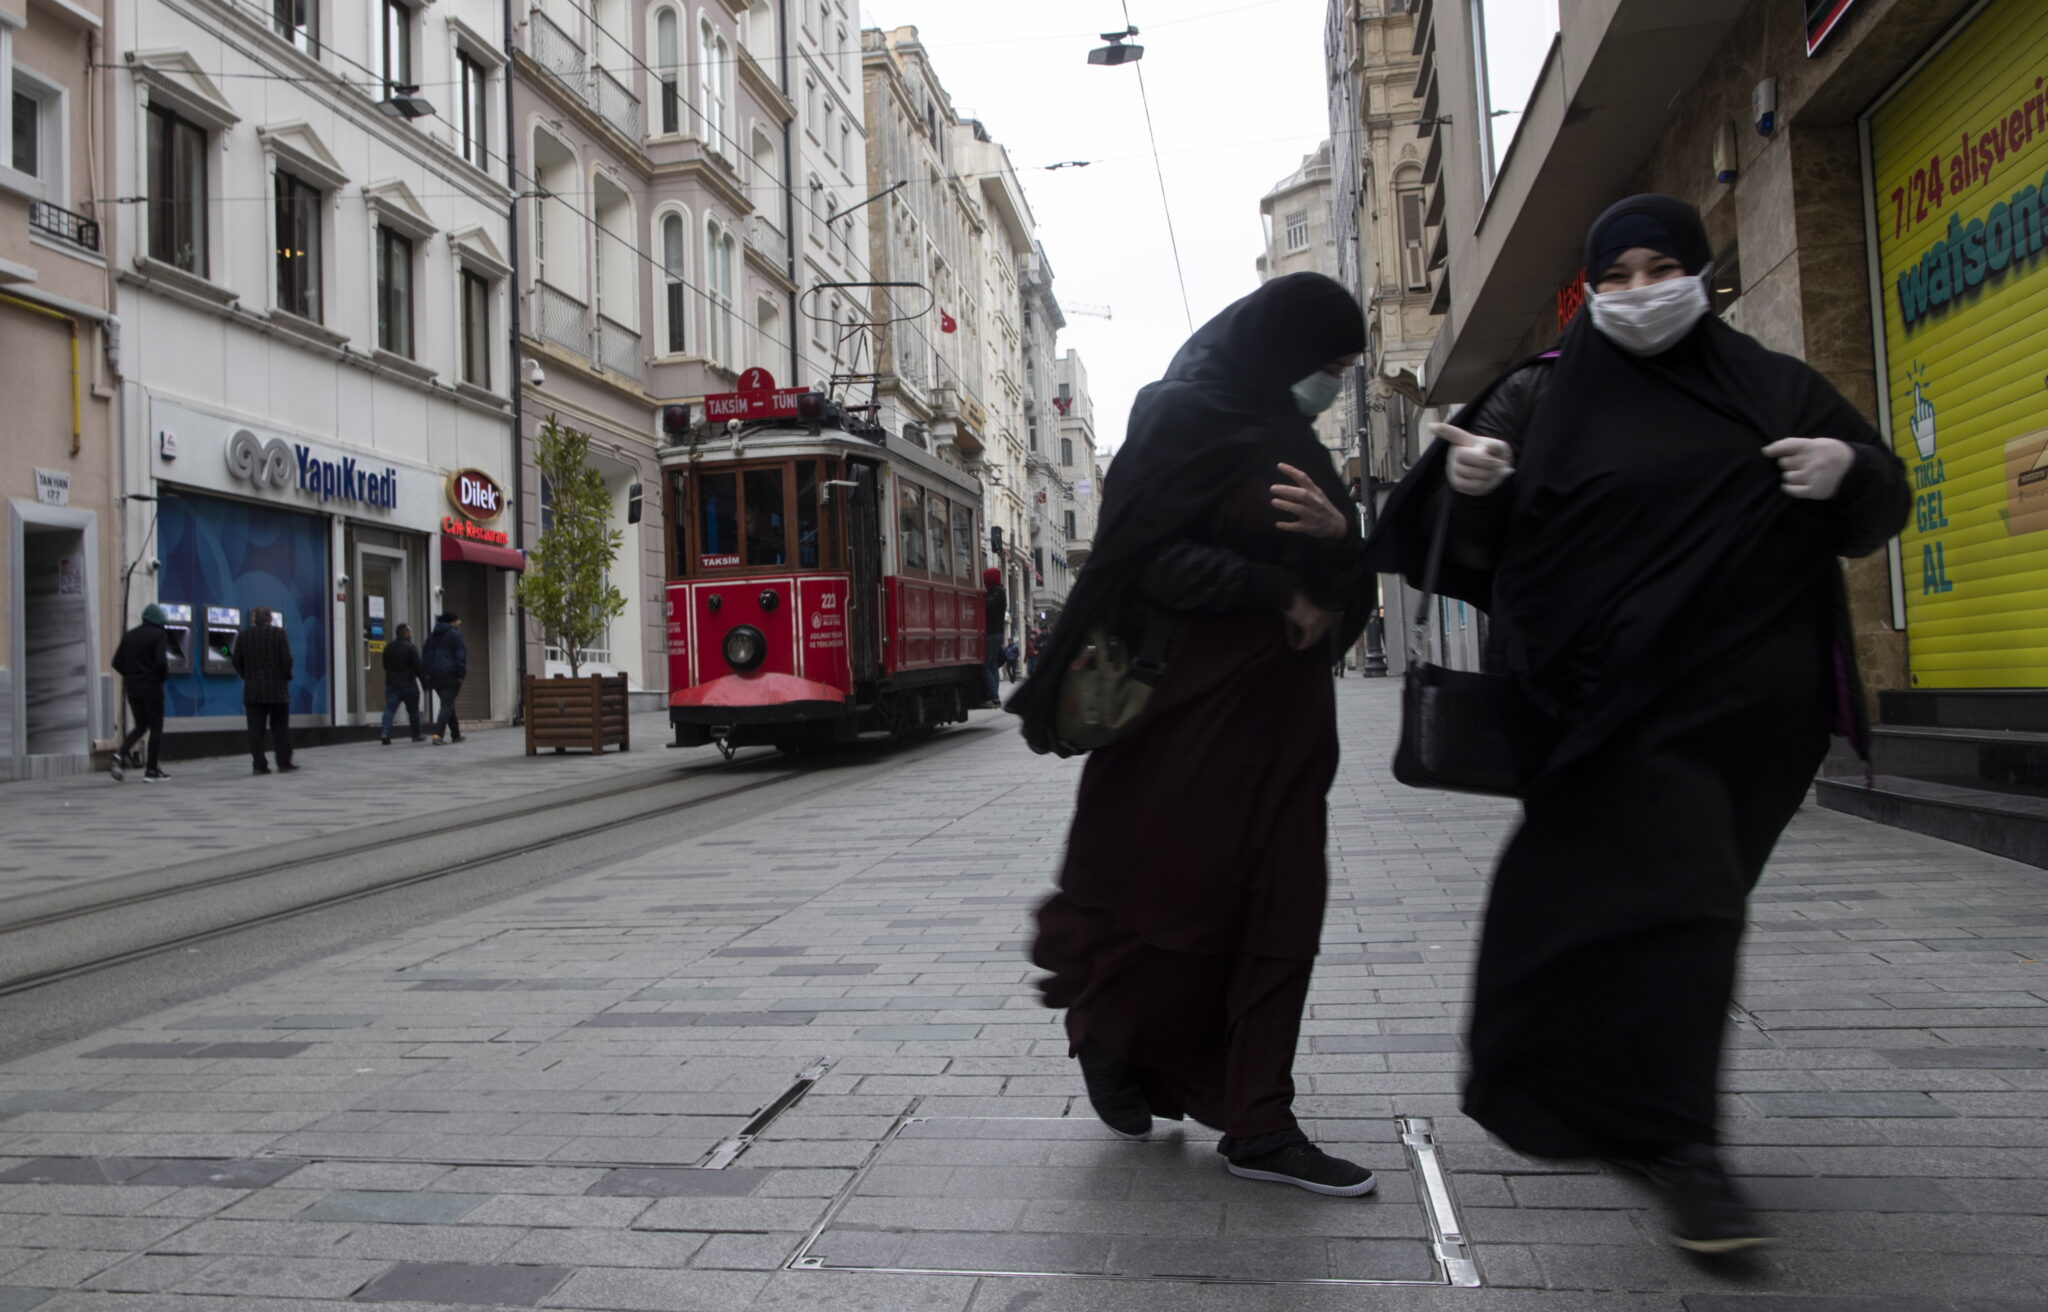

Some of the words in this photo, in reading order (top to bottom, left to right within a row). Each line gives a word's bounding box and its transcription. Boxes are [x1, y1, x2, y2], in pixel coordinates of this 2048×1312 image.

[1891, 154, 1944, 240] 7/24
[1950, 77, 2048, 196] alışveri
[751, 370, 760, 388] 2
[708, 395, 748, 415] TAKSİM
[294, 443, 397, 509] YapıKredi
[1913, 458, 1946, 490] TIKLA
[461, 477, 497, 511] Dilek
[1916, 490, 1949, 533] GEL
[702, 556, 740, 567] TAKSİM
[1923, 541, 1953, 595] AL
[821, 593, 836, 609] 223
